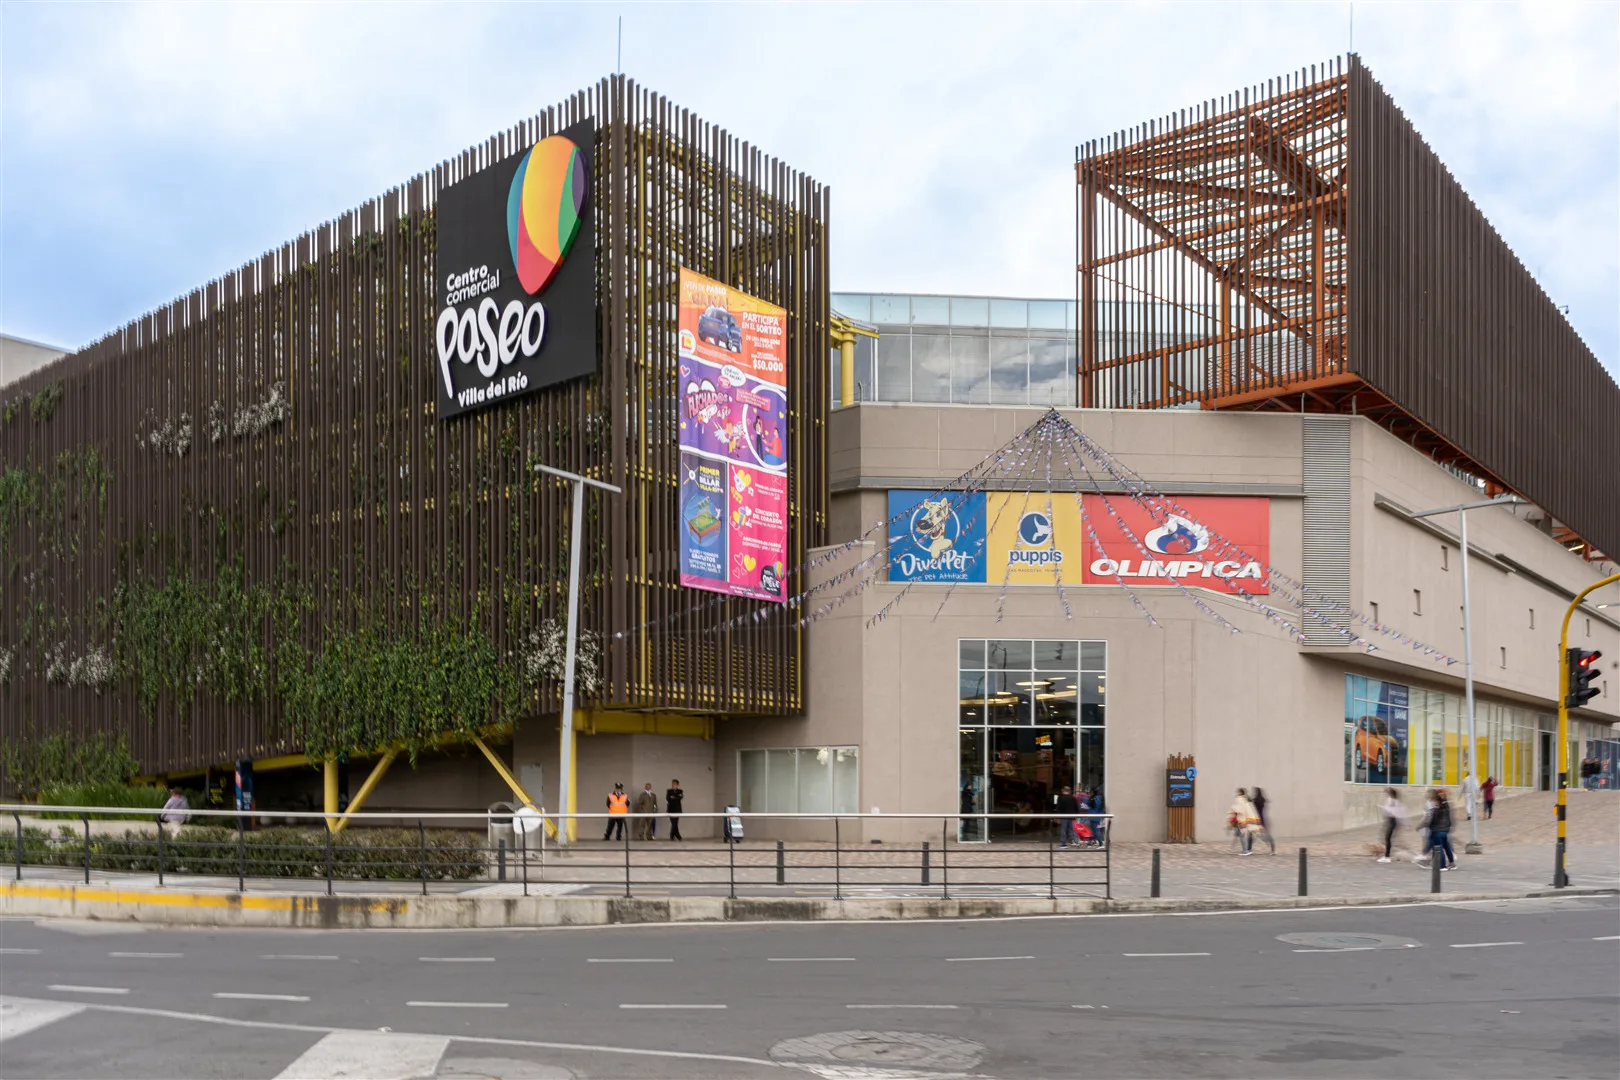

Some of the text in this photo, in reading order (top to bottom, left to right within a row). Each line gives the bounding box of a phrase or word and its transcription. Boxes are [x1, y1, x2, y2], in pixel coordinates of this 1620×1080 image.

[446, 264, 488, 292] Centro
[446, 268, 500, 306] comercial
[742, 311, 779, 327] PARTICIPA
[742, 321, 749, 329] EN
[756, 323, 782, 336] SORTEO
[752, 358, 784, 373] $50.000
[458, 371, 528, 408] Villa del Río
[699, 465, 720, 477] PRIMER
[893, 549, 974, 576] DiverPet
[1009, 548, 1063, 565] puppis
[1089, 558, 1262, 579] OLIMPICA
[1188, 769, 1195, 779] 2
